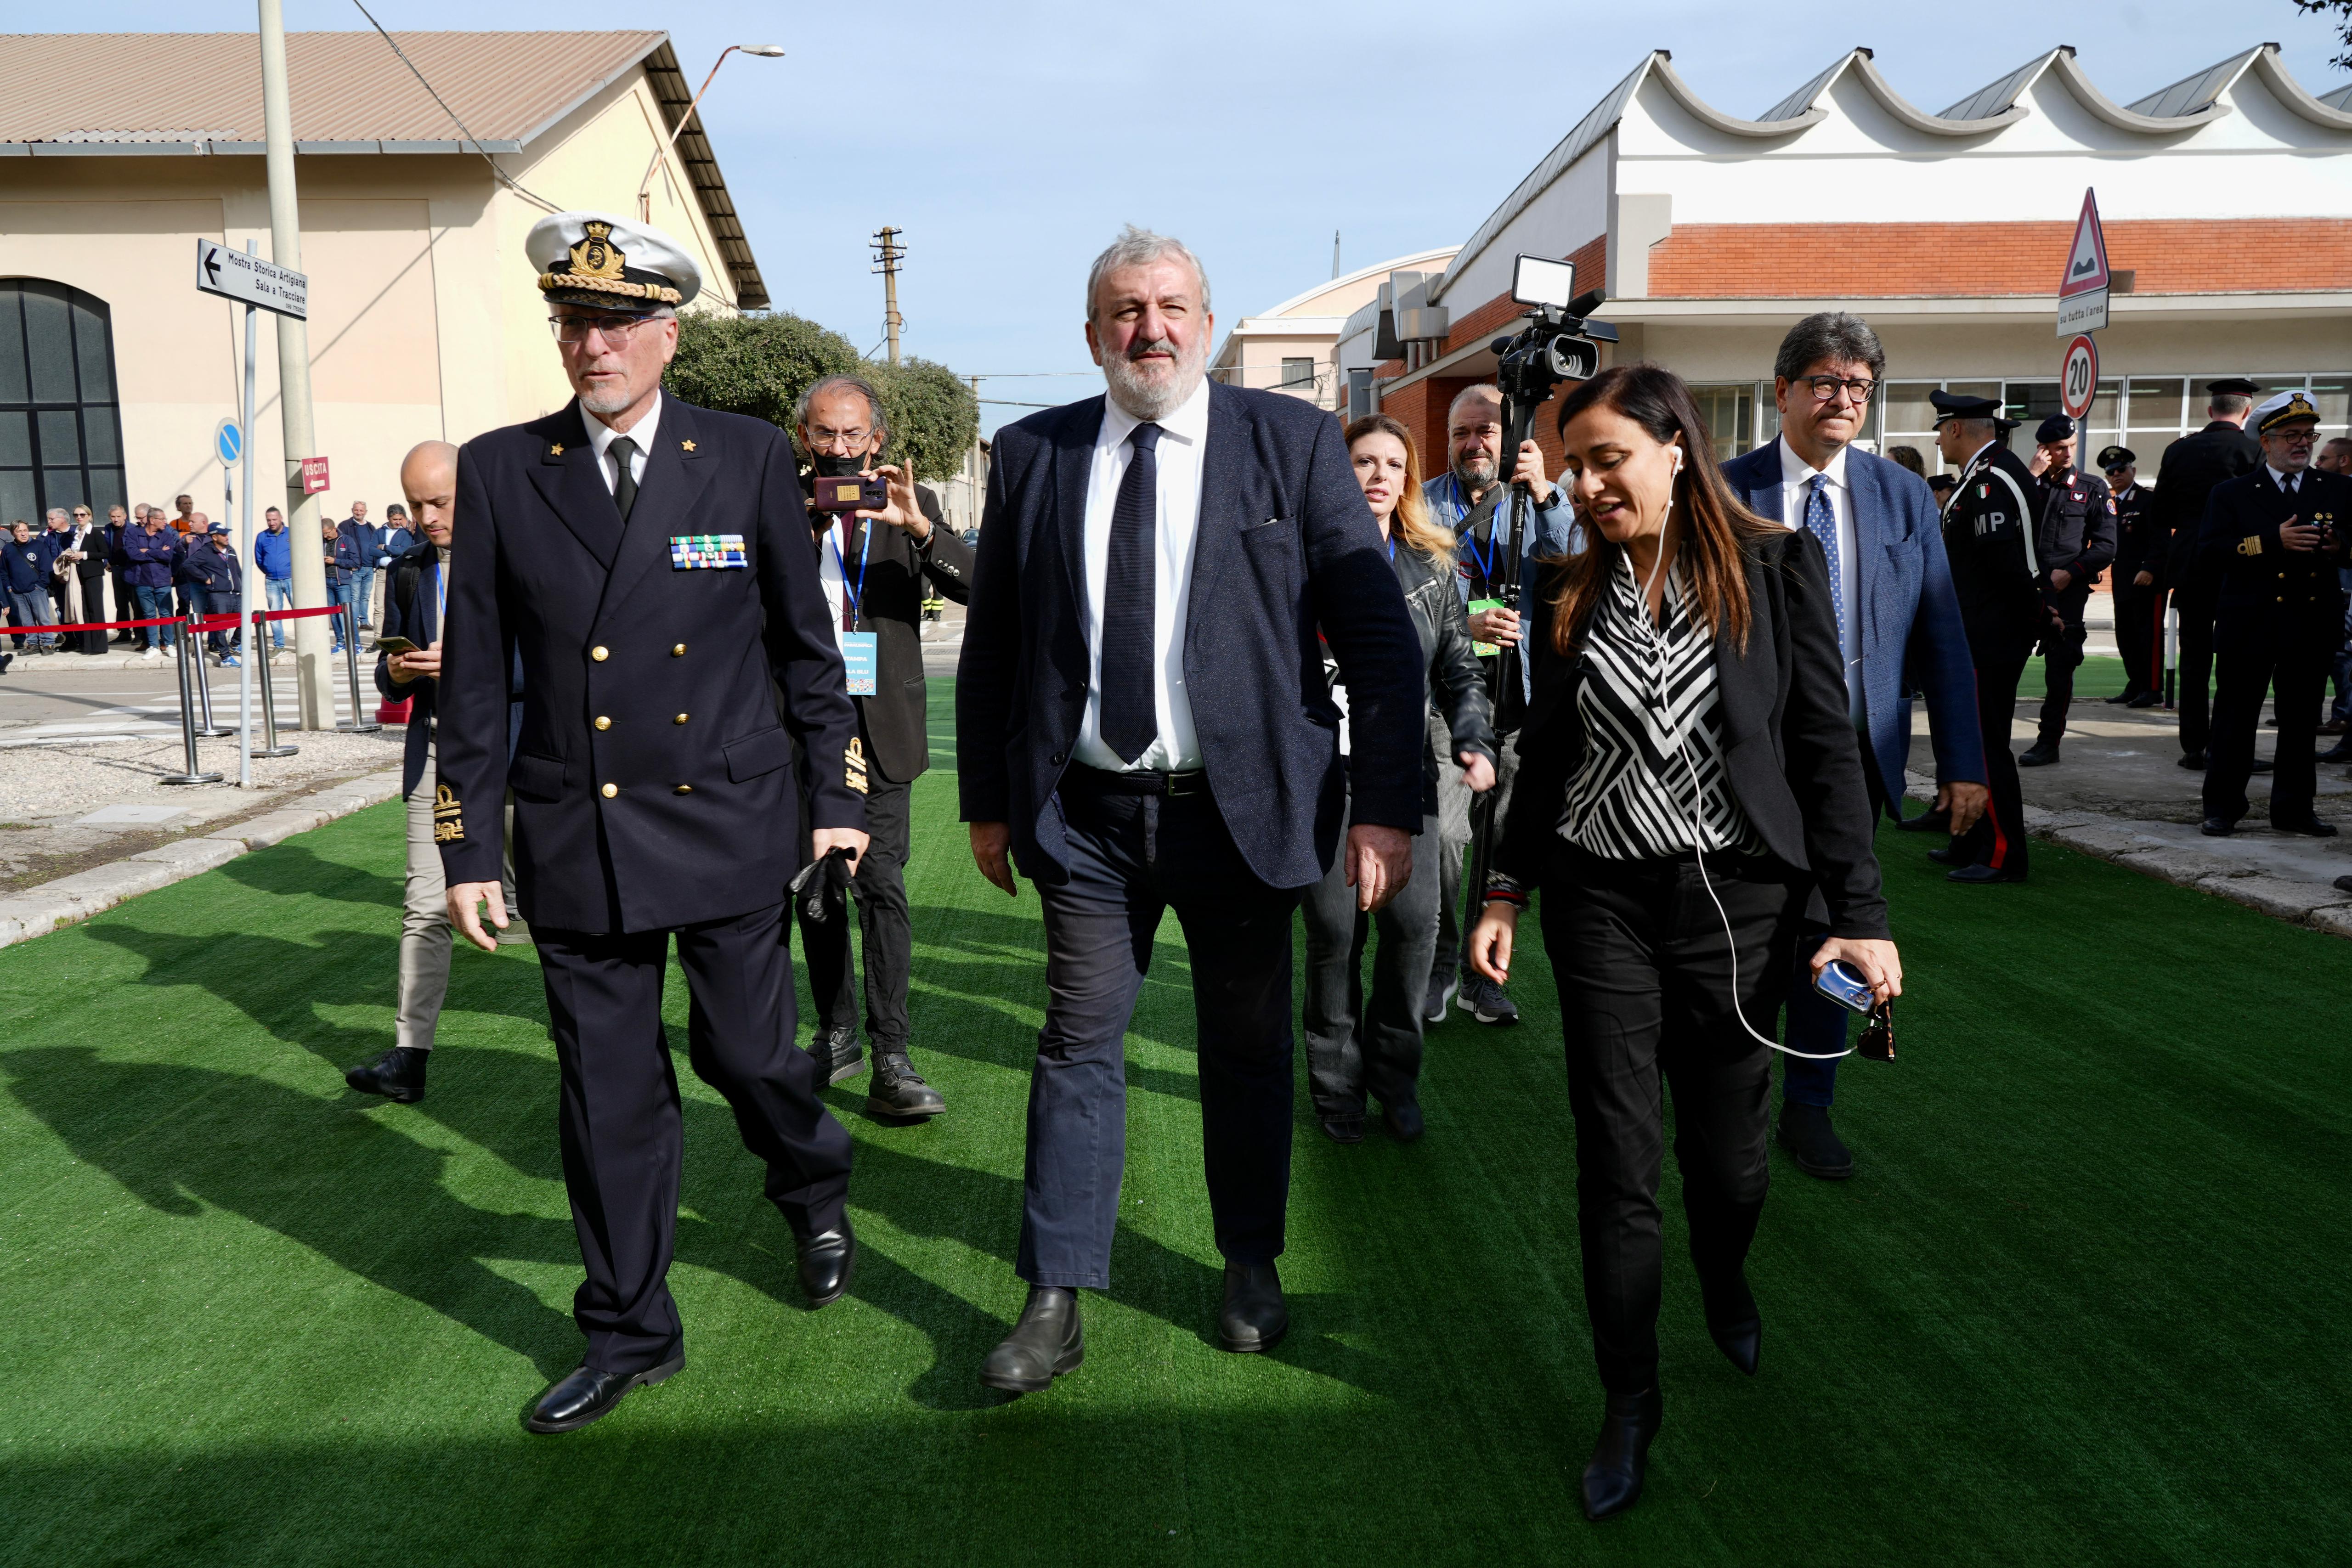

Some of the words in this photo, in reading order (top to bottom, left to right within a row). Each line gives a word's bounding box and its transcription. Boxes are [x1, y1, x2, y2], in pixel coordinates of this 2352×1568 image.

[228, 252, 250, 269] Mostra
[254, 261, 276, 278] Storica
[279, 270, 305, 288] Artigiana
[256, 279, 269, 293] Sala
[279, 287, 305, 304] Tracciare
[2059, 316, 2066, 324] su
[2069, 309, 2084, 321] tutta
[2086, 305, 2103, 317] l'area
[1516, 356, 1527, 393] Panasonic
[2069, 357, 2088, 396] 20
[305, 463, 327, 476] USCITA
[1974, 512, 2005, 537] MP
